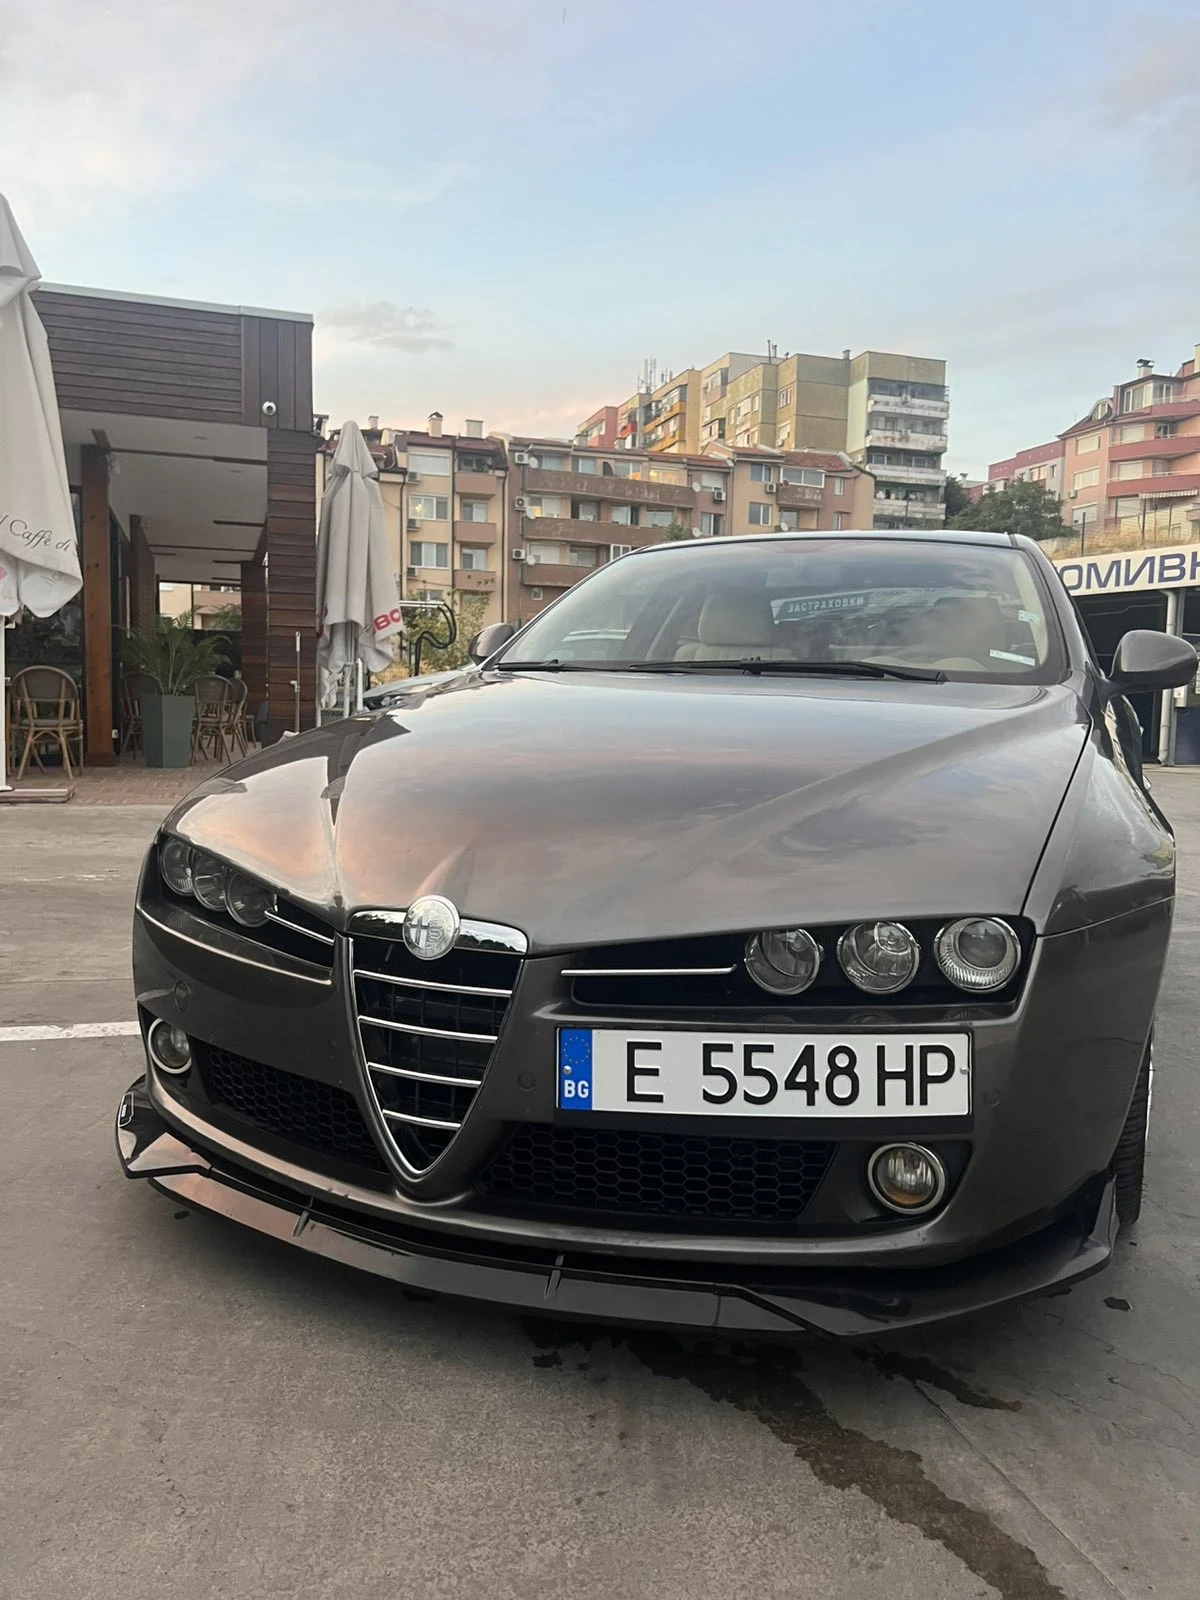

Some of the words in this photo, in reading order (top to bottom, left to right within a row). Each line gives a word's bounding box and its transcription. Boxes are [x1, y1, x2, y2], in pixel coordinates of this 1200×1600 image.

[9, 519, 53, 549] Caffè
[55, 538, 72, 551] di
[563, 1079, 590, 1099] BG
[625, 1040, 664, 1102] E
[702, 1043, 860, 1107] 5548
[876, 1044, 955, 1106] HP
